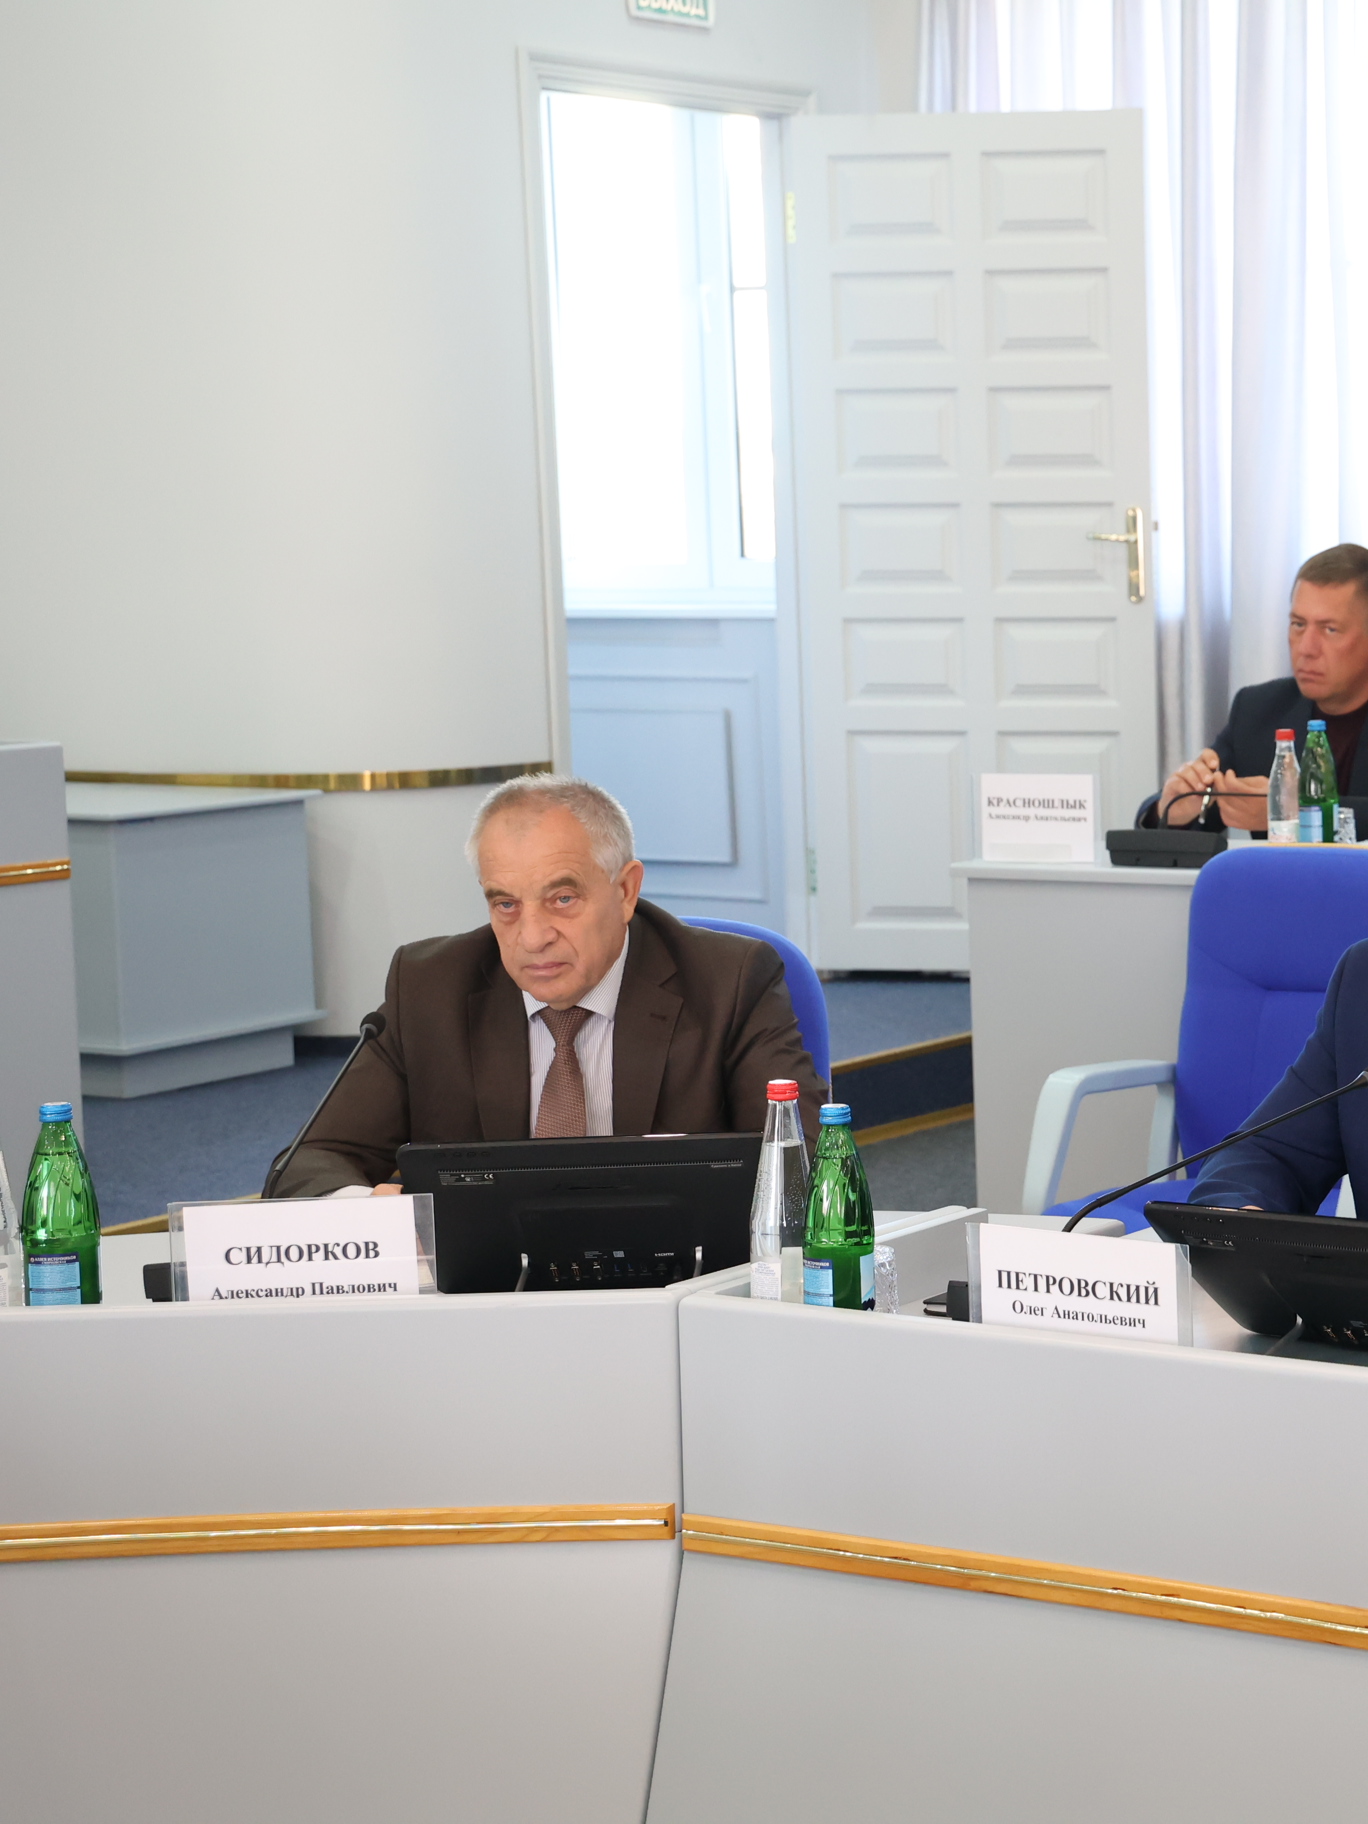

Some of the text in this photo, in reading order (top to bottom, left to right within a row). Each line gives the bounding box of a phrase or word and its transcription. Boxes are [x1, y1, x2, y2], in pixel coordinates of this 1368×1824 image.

[987, 797, 1087, 810] КРАСНОШЛЫК
[224, 1241, 380, 1268] СИДОРКОВ
[211, 1281, 399, 1300] Александр Павлович
[996, 1269, 1160, 1306] ПЕТРОВСКИЙ
[1012, 1300, 1146, 1328] Олег Анатольевич
